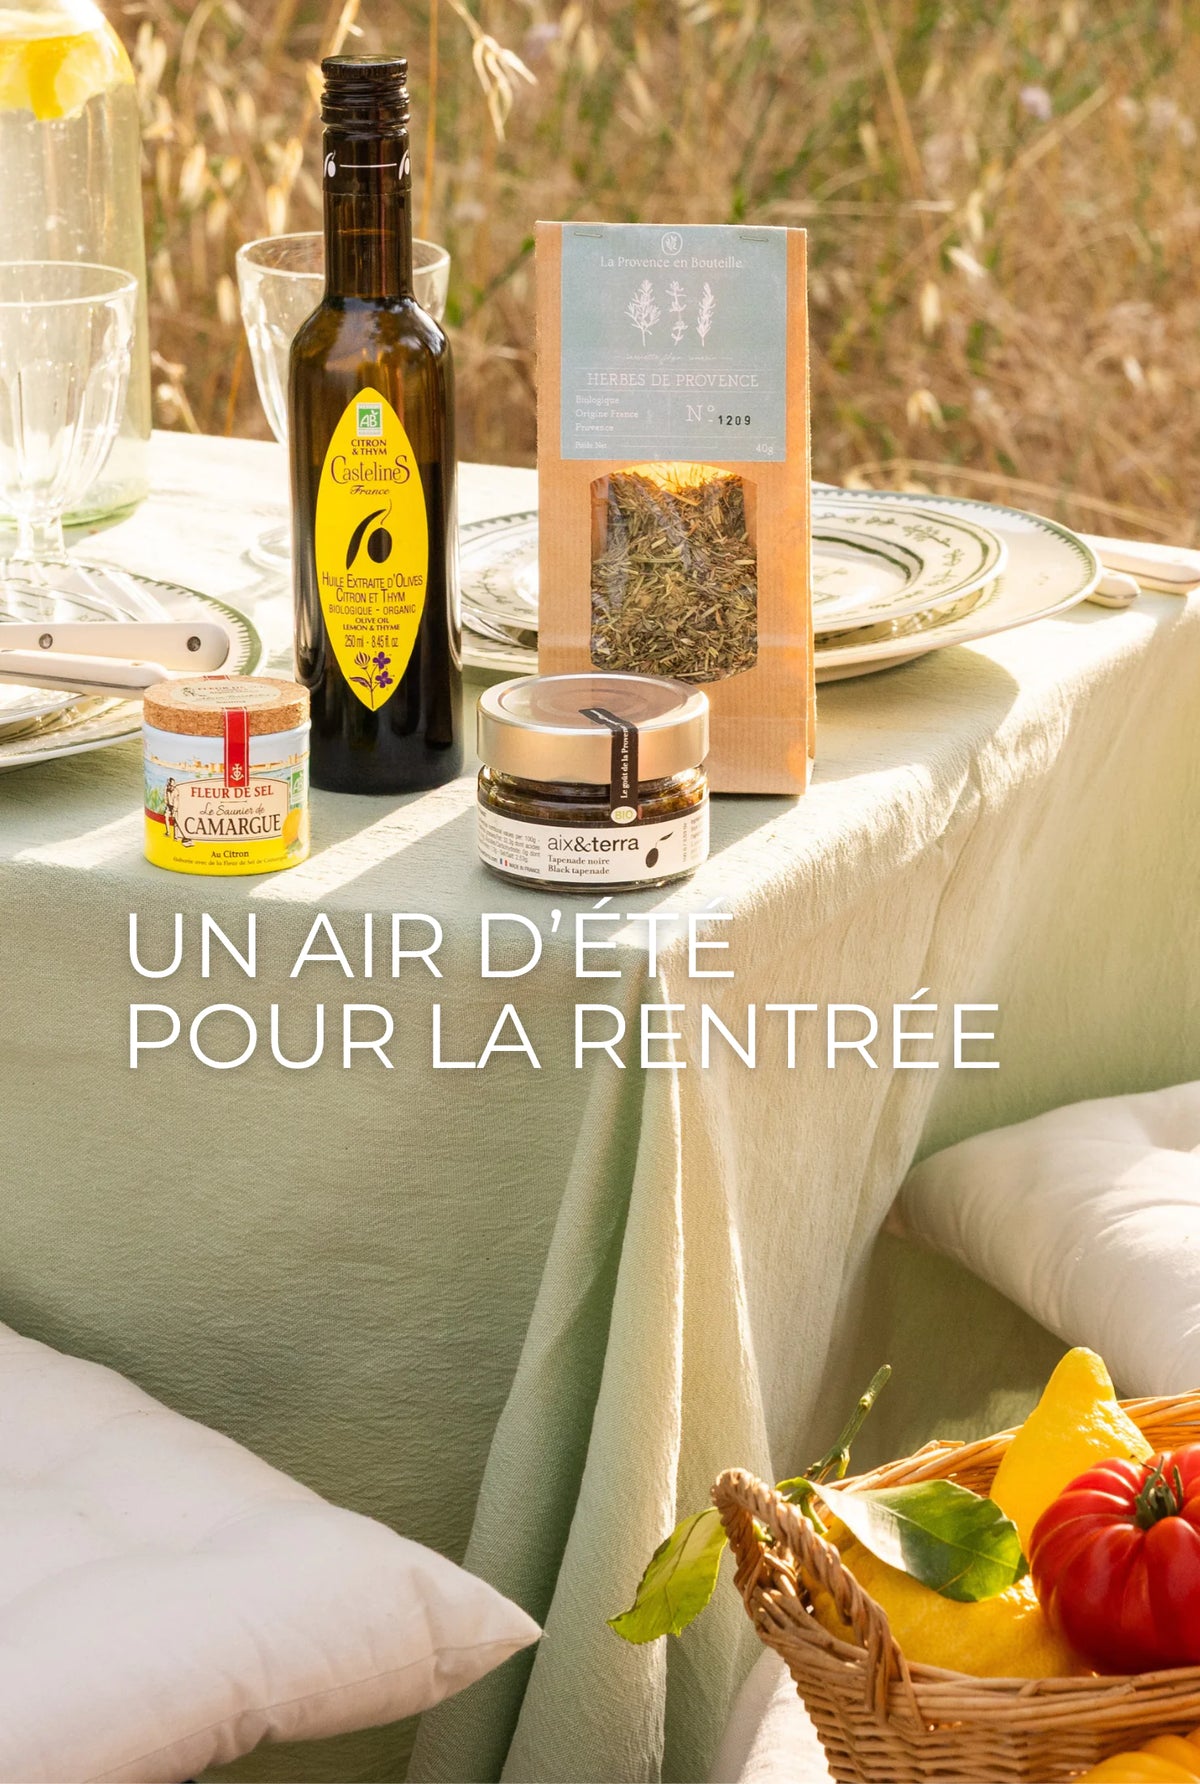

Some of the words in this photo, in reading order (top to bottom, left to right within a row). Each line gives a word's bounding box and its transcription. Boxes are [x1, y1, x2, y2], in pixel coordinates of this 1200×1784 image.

[600, 256, 614, 268] La
[618, 256, 670, 268] Provence
[673, 257, 688, 268] en
[691, 256, 743, 269] Bouteille
[587, 372, 646, 387] HERBES
[651, 373, 671, 387] DE
[676, 374, 759, 388] PROVENCE
[575, 395, 619, 406] Biologique
[575, 408, 608, 419] Origine
[610, 410, 639, 418] France
[360, 414, 378, 427] AB
[718, 415, 751, 426] 1209
[575, 423, 614, 432] Provence
[351, 439, 387, 447] CITRON
[352, 448, 359, 456] &
[360, 447, 387, 456] THYM
[756, 443, 774, 456] 40g
[350, 484, 390, 495] France
[336, 587, 366, 603] CITRON
[369, 593, 378, 603] ET
[381, 588, 406, 603] THYM
[329, 604, 372, 616] BIOLOGIQUE
[383, 604, 416, 616] ORGANIC
[345, 635, 355, 648] 250
[621, 754, 629, 762] la
[621, 762, 629, 772] de
[191, 786, 230, 799] FLEUR
[234, 785, 250, 799] DE
[254, 785, 274, 797] SEL
[620, 791, 628, 799] Le
[200, 802, 215, 816] Le
[216, 803, 253, 816] Saunier
[255, 802, 265, 815] de
[615, 809, 633, 820] BIO
[184, 813, 281, 836] CAMARGUE
[547, 834, 639, 852] aix&terra
[223, 850, 249, 858] Citron
[548, 855, 585, 866] Tapenade
[588, 856, 610, 864] noire
[548, 865, 570, 874] Black
[572, 867, 610, 876] tapenade
